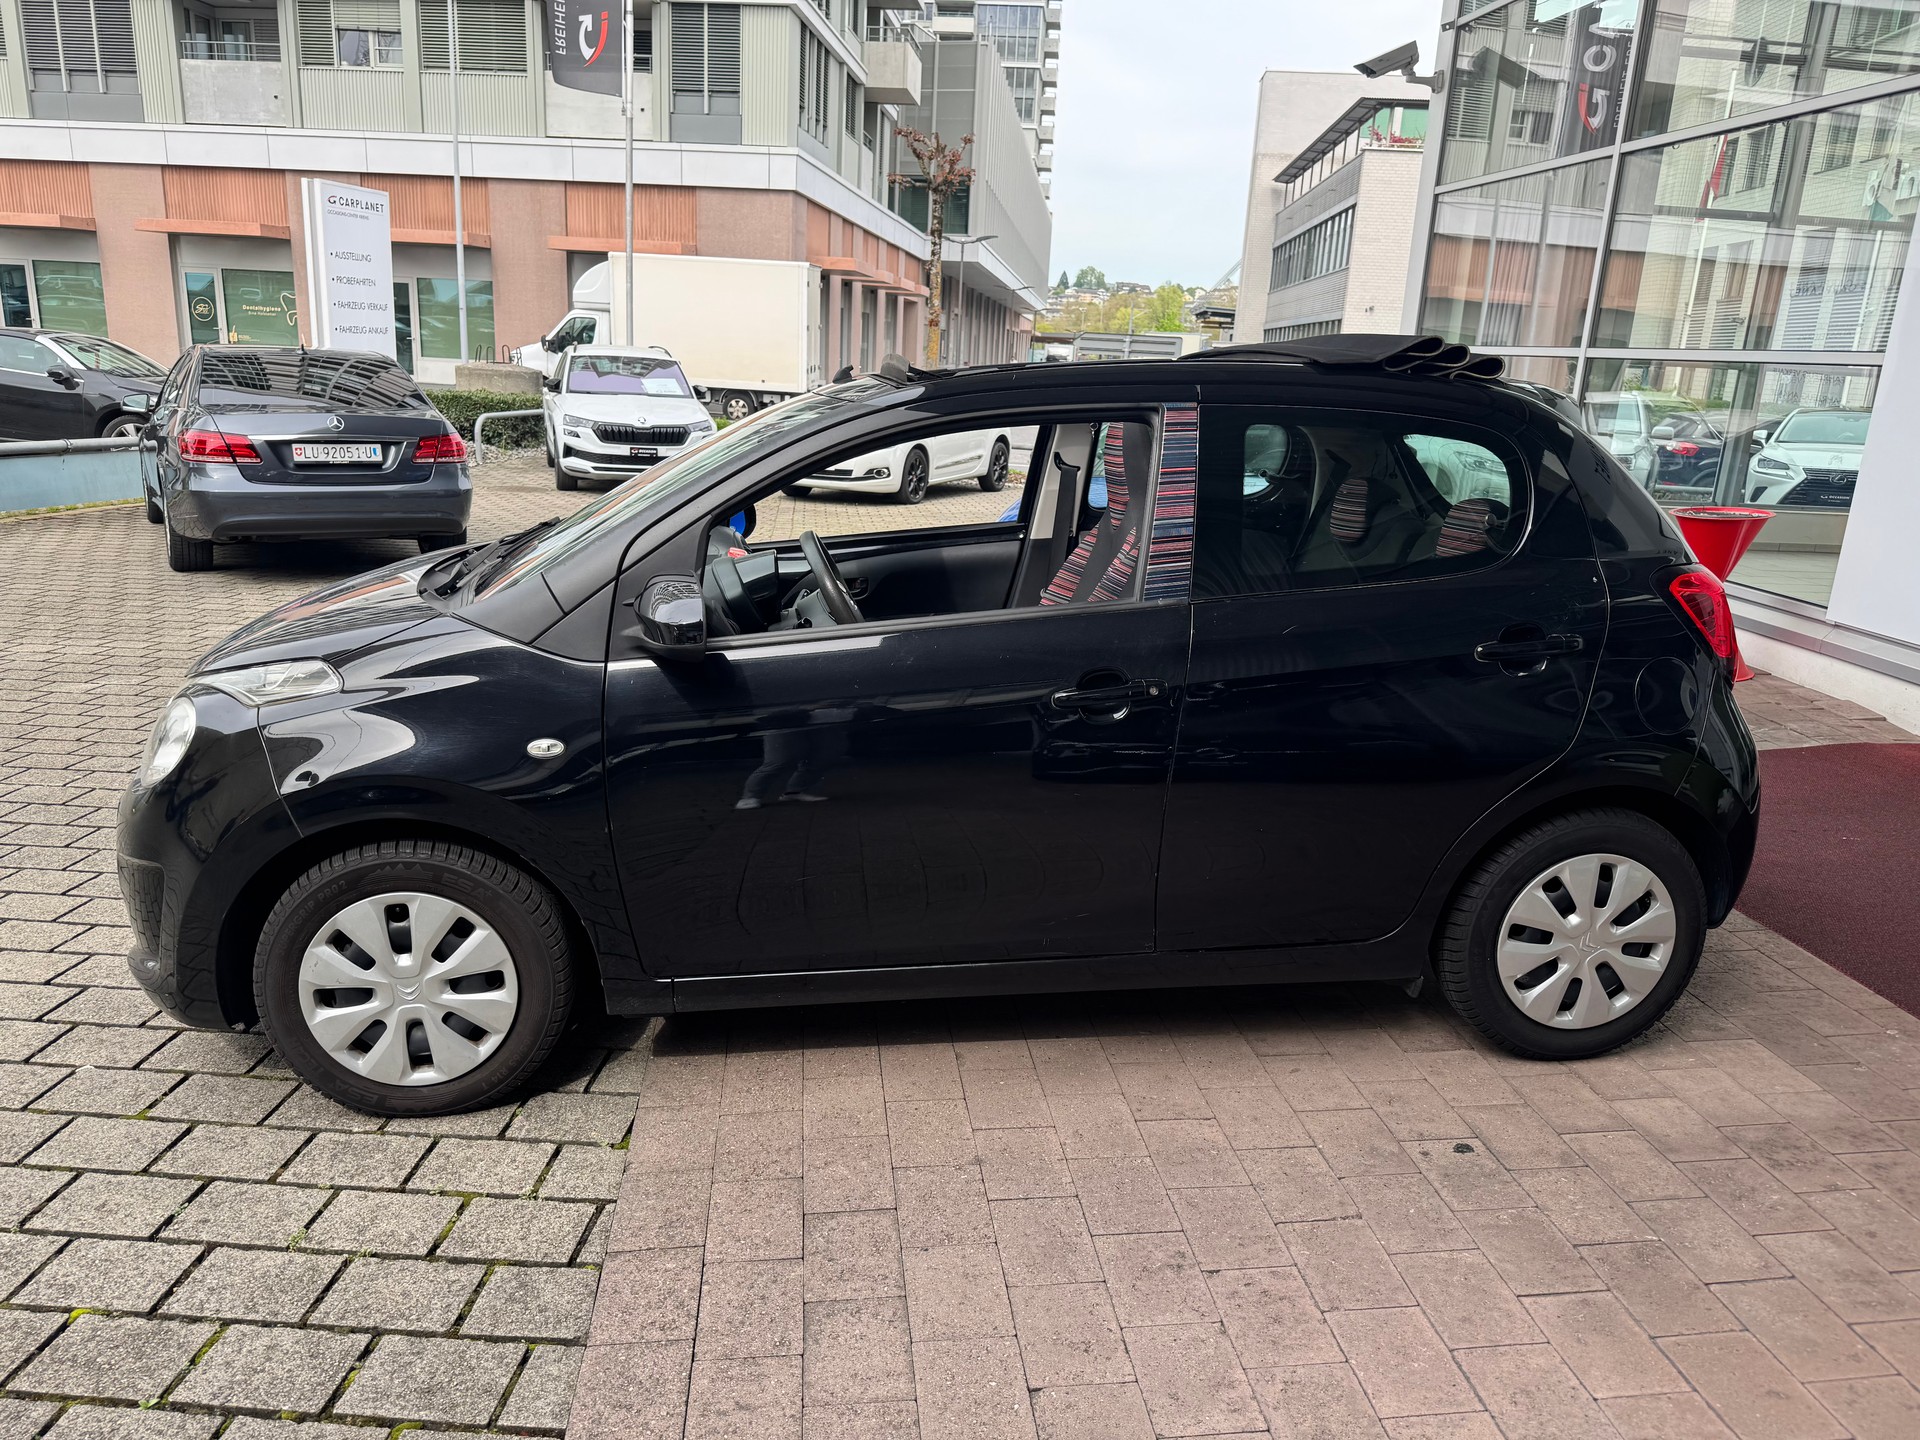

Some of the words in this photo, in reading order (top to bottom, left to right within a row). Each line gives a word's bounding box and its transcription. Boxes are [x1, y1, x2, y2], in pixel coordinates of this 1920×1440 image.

[338, 196, 384, 213] CARPLANET
[335, 251, 372, 263] AUSSTELLUNG
[336, 275, 377, 287] PROBEFAHRTEN
[338, 300, 366, 311] FAHRZEUG
[366, 302, 388, 312] VERKAUF
[339, 325, 368, 335] FAHRZEUG
[368, 326, 389, 335] ANKAUF
